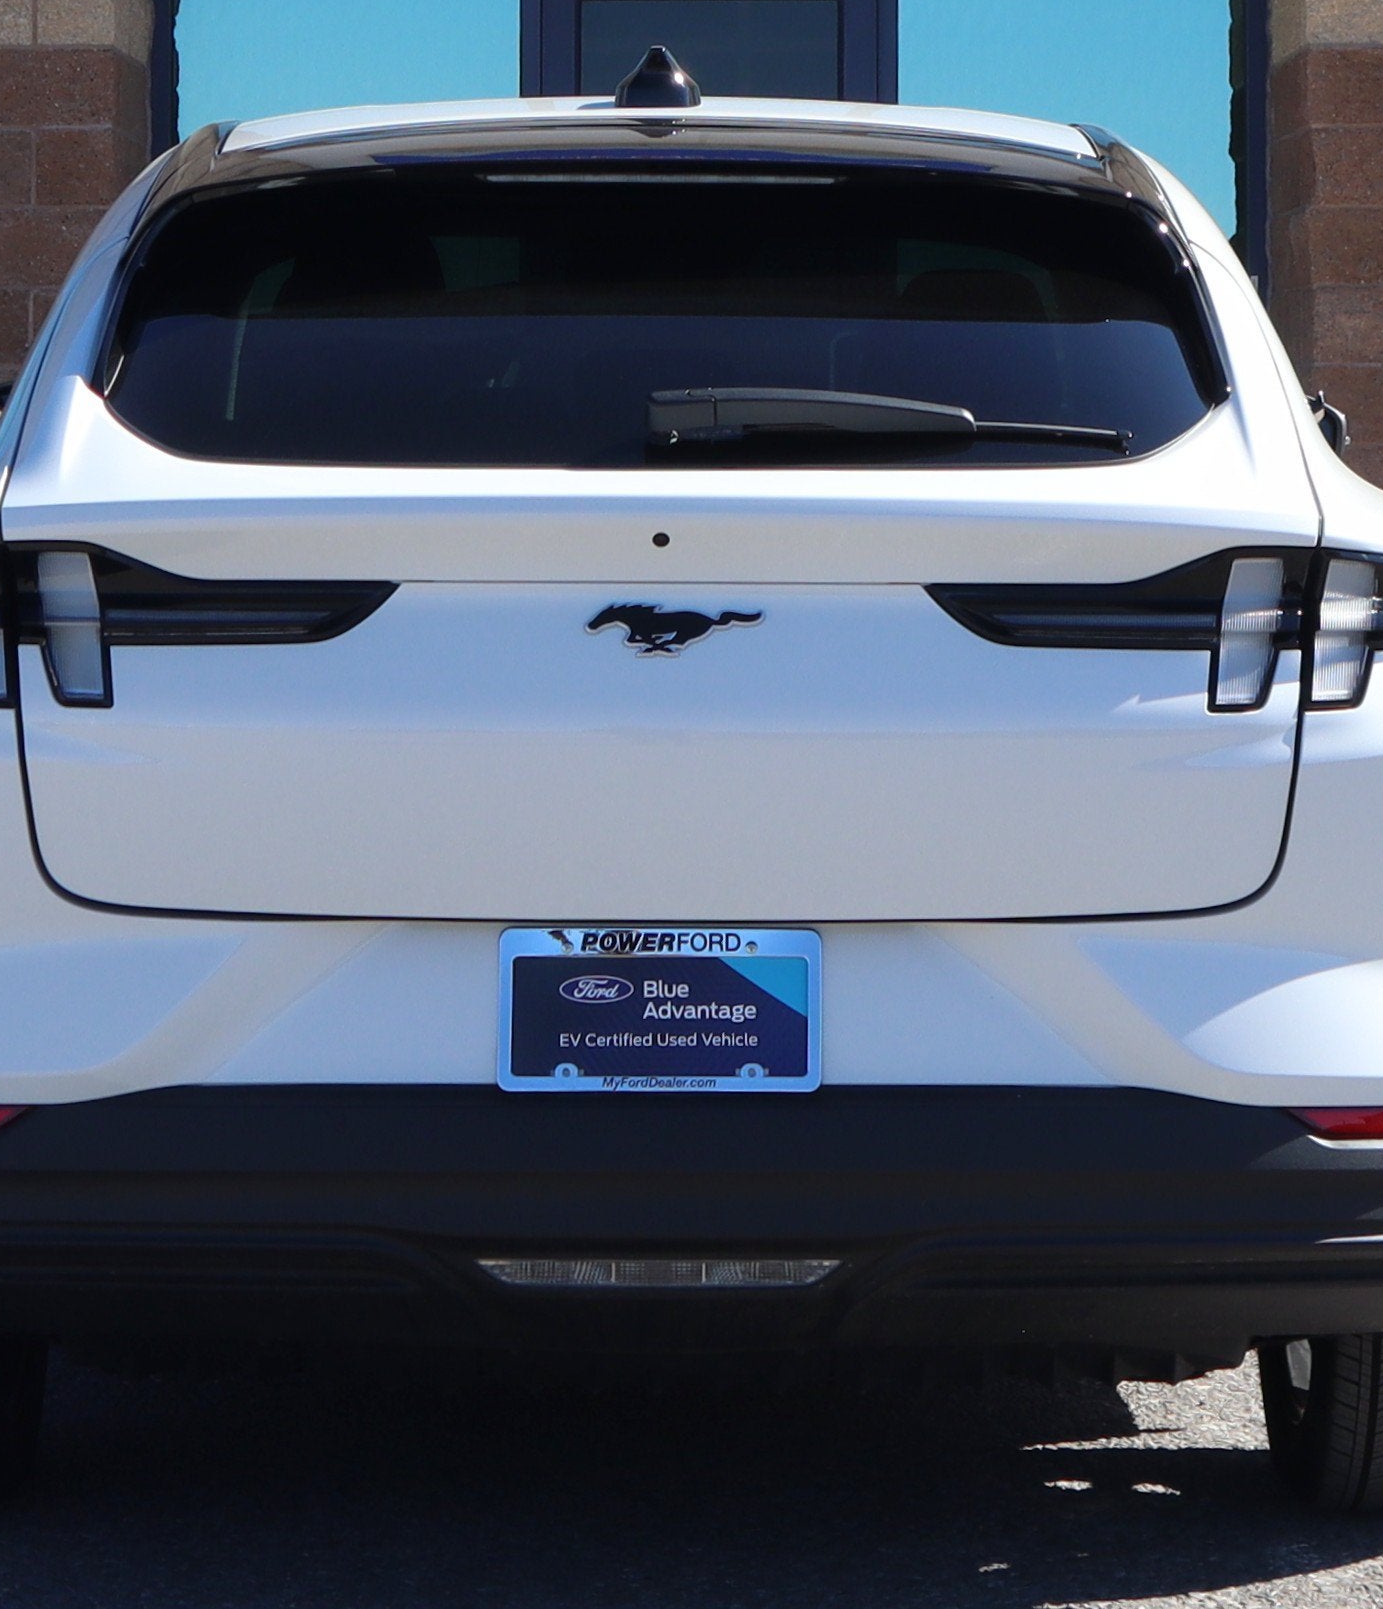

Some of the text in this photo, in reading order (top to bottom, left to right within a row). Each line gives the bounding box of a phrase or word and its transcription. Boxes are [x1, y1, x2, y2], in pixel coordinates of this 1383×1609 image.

[573, 979, 620, 999] Ford
[643, 980, 689, 998] Blue
[642, 1002, 757, 1023] Advantage
[559, 1032, 758, 1047] EV Certified Used Vehicle
[602, 1077, 716, 1090] MyFordDealer.com
